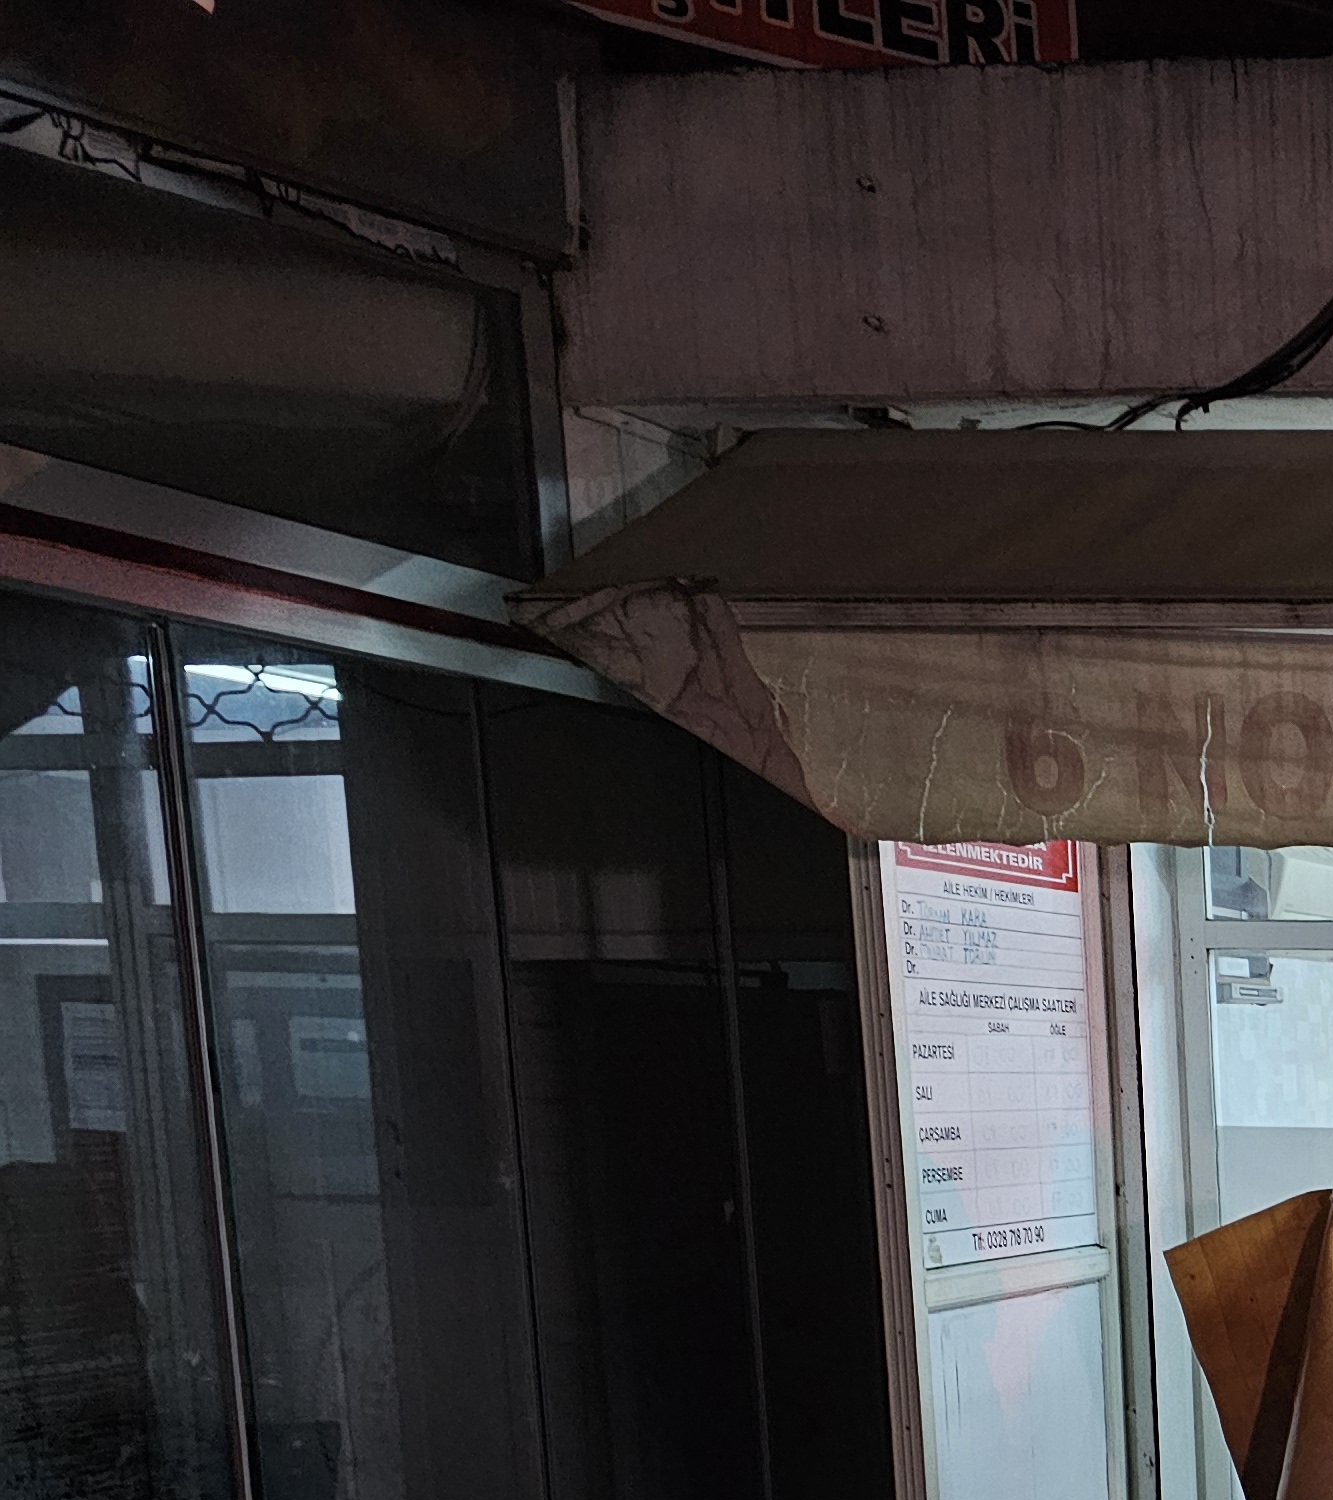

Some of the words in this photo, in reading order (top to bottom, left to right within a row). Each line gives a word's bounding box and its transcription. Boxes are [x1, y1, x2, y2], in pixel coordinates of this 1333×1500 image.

[943, 879, 961, 897] AİLE
[963, 884, 988, 899] HEKİM
[994, 889, 1035, 907] HEKİMLERİ
[902, 899, 915, 915] Dr.
[903, 921, 916, 936] Dr.
[905, 942, 918, 956] Dr.
[906, 960, 920, 974] Dr.
[919, 987, 937, 1006] AİLE
[938, 989, 972, 1009] SAĞLIĞI
[973, 992, 1006, 1010] MERKEZİ
[1008, 995, 1040, 1013] ÇALIŞMA
[1042, 997, 1077, 1014] SAATLERİ
[912, 1041, 955, 1060] PAZARTESİ
[915, 1085, 933, 1101] SALI
[919, 1126, 962, 1145] ÇARŞAMBA
[922, 1166, 963, 1185] PERŞEMBE
[926, 1208, 948, 1225] CUMA
[987, 1230, 1008, 1249] 0328
[1009, 1228, 1022, 1247] 718
[1023, 1226, 1033, 1244] 70
[1035, 1225, 1045, 1242] 90
